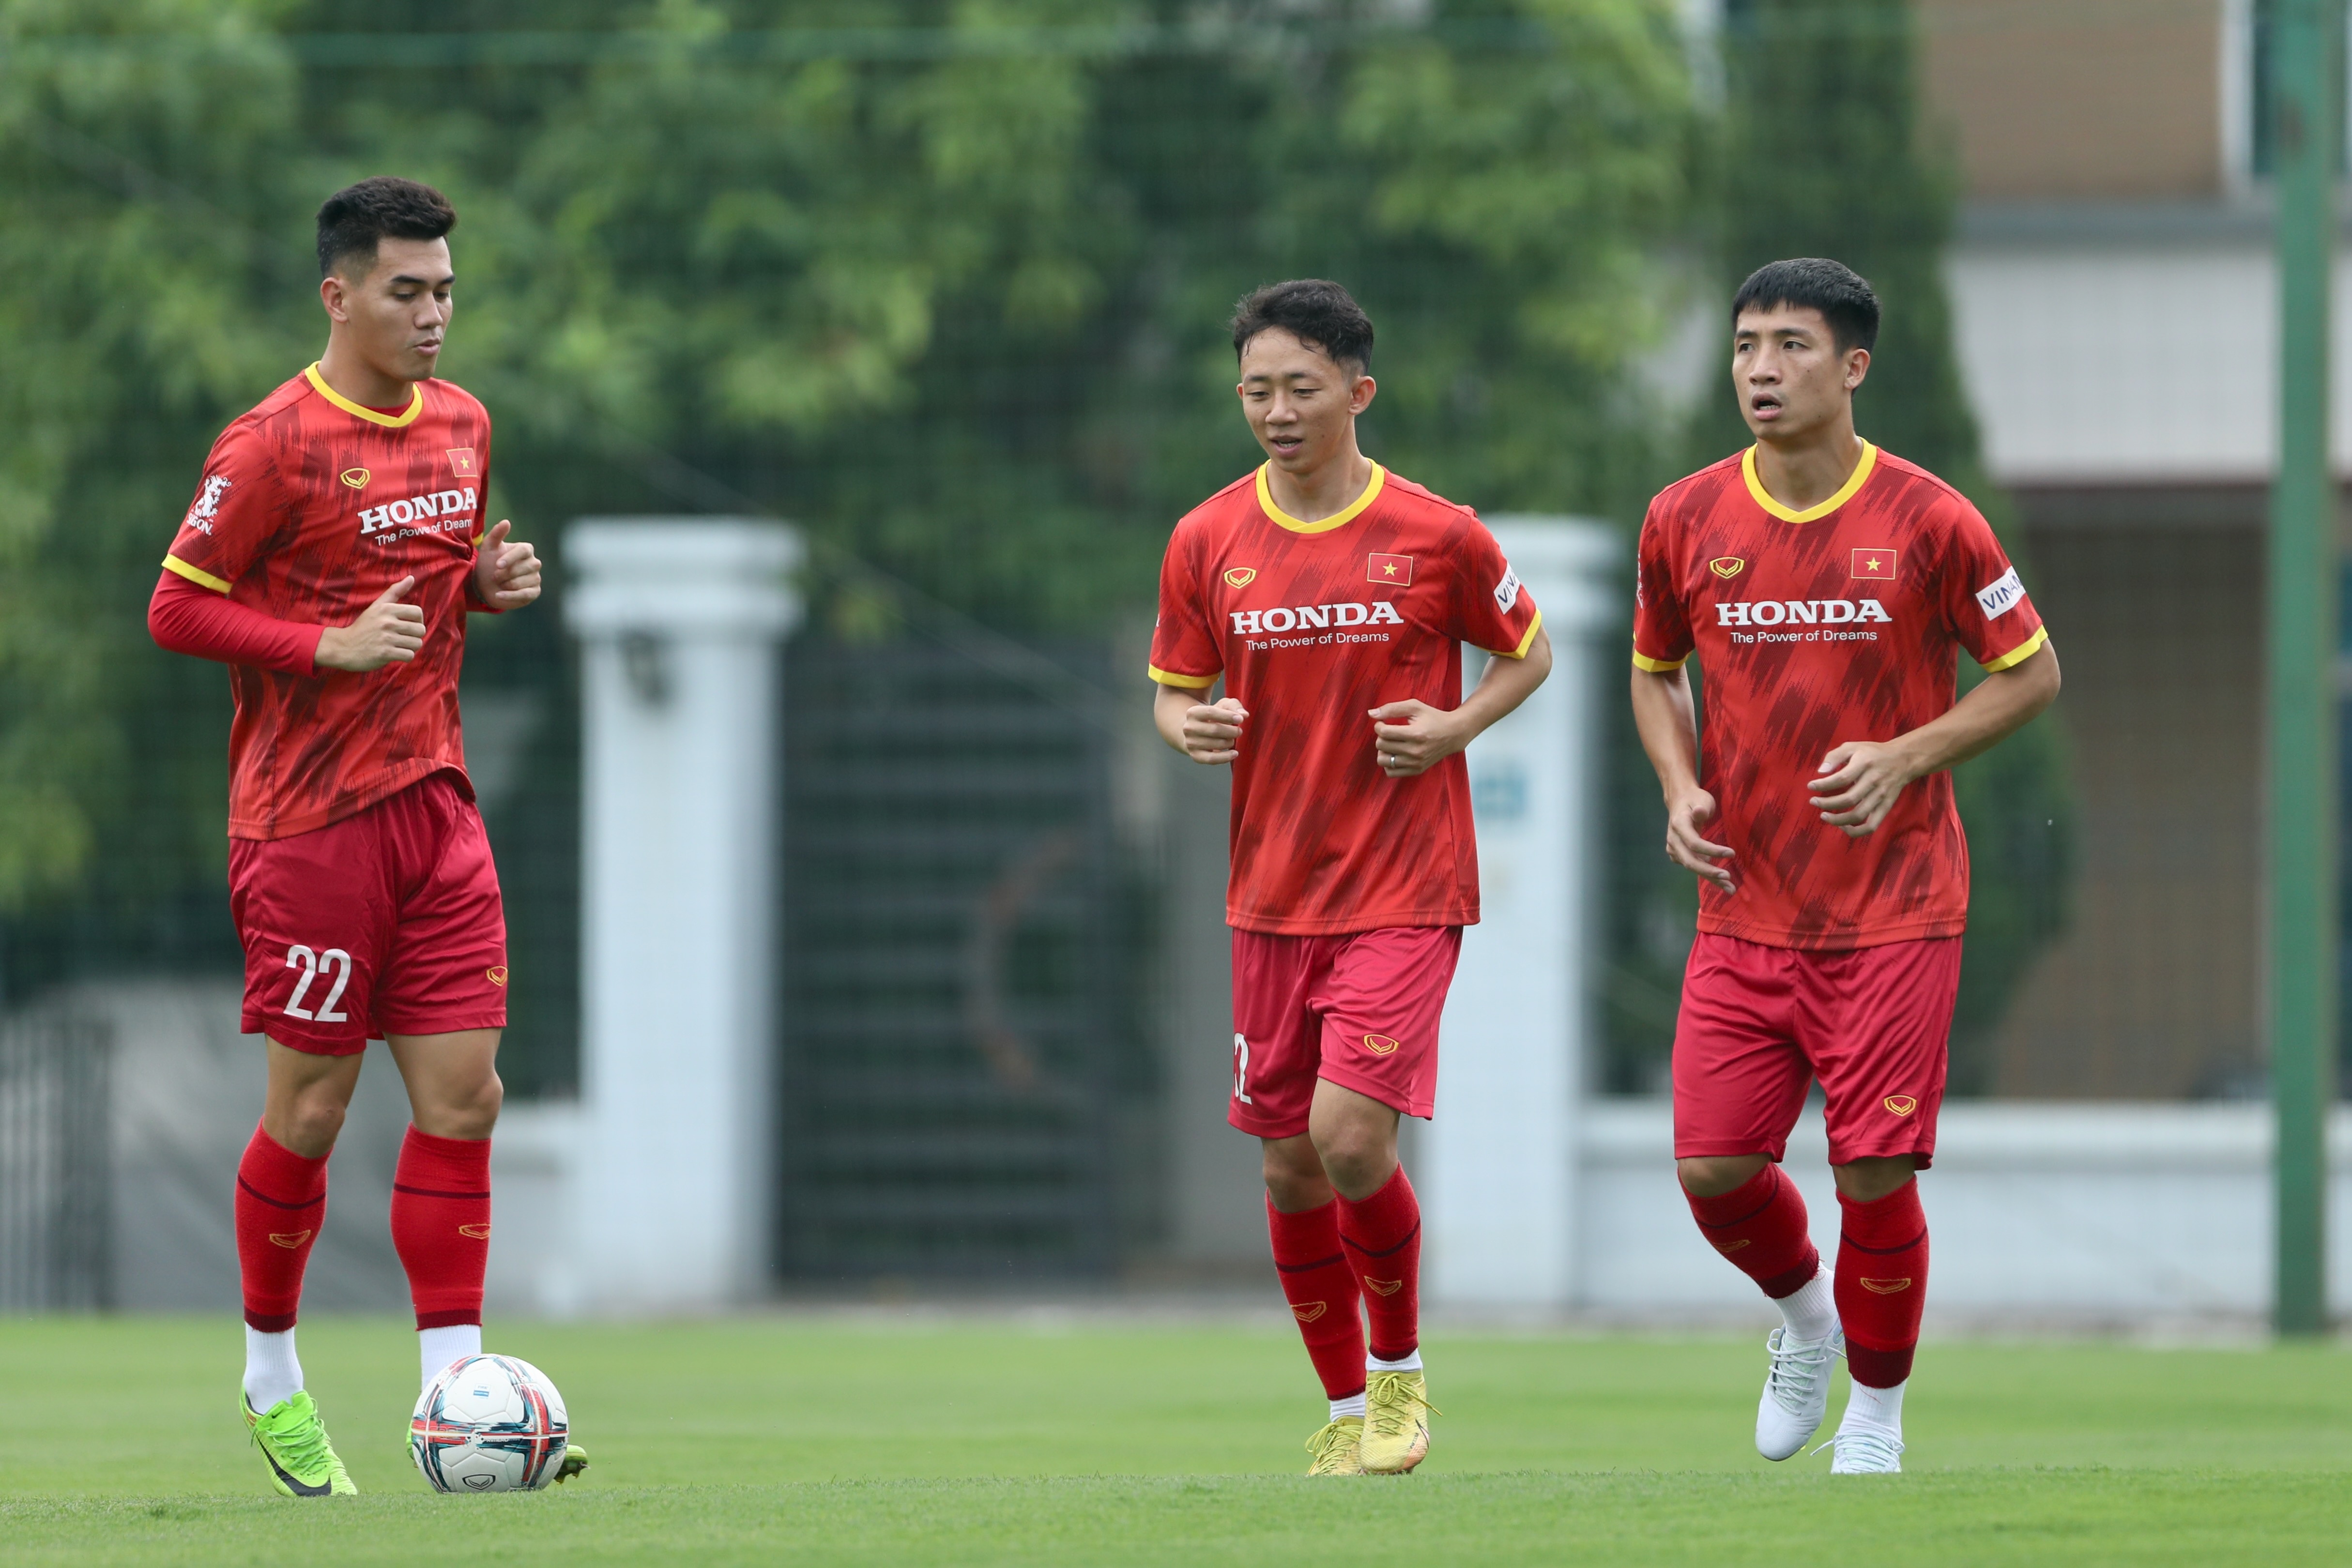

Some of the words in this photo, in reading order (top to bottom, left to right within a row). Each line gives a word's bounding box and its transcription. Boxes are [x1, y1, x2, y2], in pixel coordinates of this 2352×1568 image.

[357, 487, 477, 534] HONDA
[375, 533, 396, 546] The
[431, 521, 442, 533] of
[444, 518, 473, 531] Dream
[1229, 601, 1404, 635] HONDA
[1715, 599, 1893, 626] HONDA
[1246, 639, 1268, 651] The
[1271, 636, 1315, 649] Power
[1318, 633, 1333, 644] of
[1336, 632, 1389, 643] Dreams
[1730, 632, 1754, 643] The
[1757, 632, 1803, 642] Power
[1806, 630, 1820, 641] of
[1823, 630, 1878, 641] Dreams
[283, 944, 351, 1022] 22
